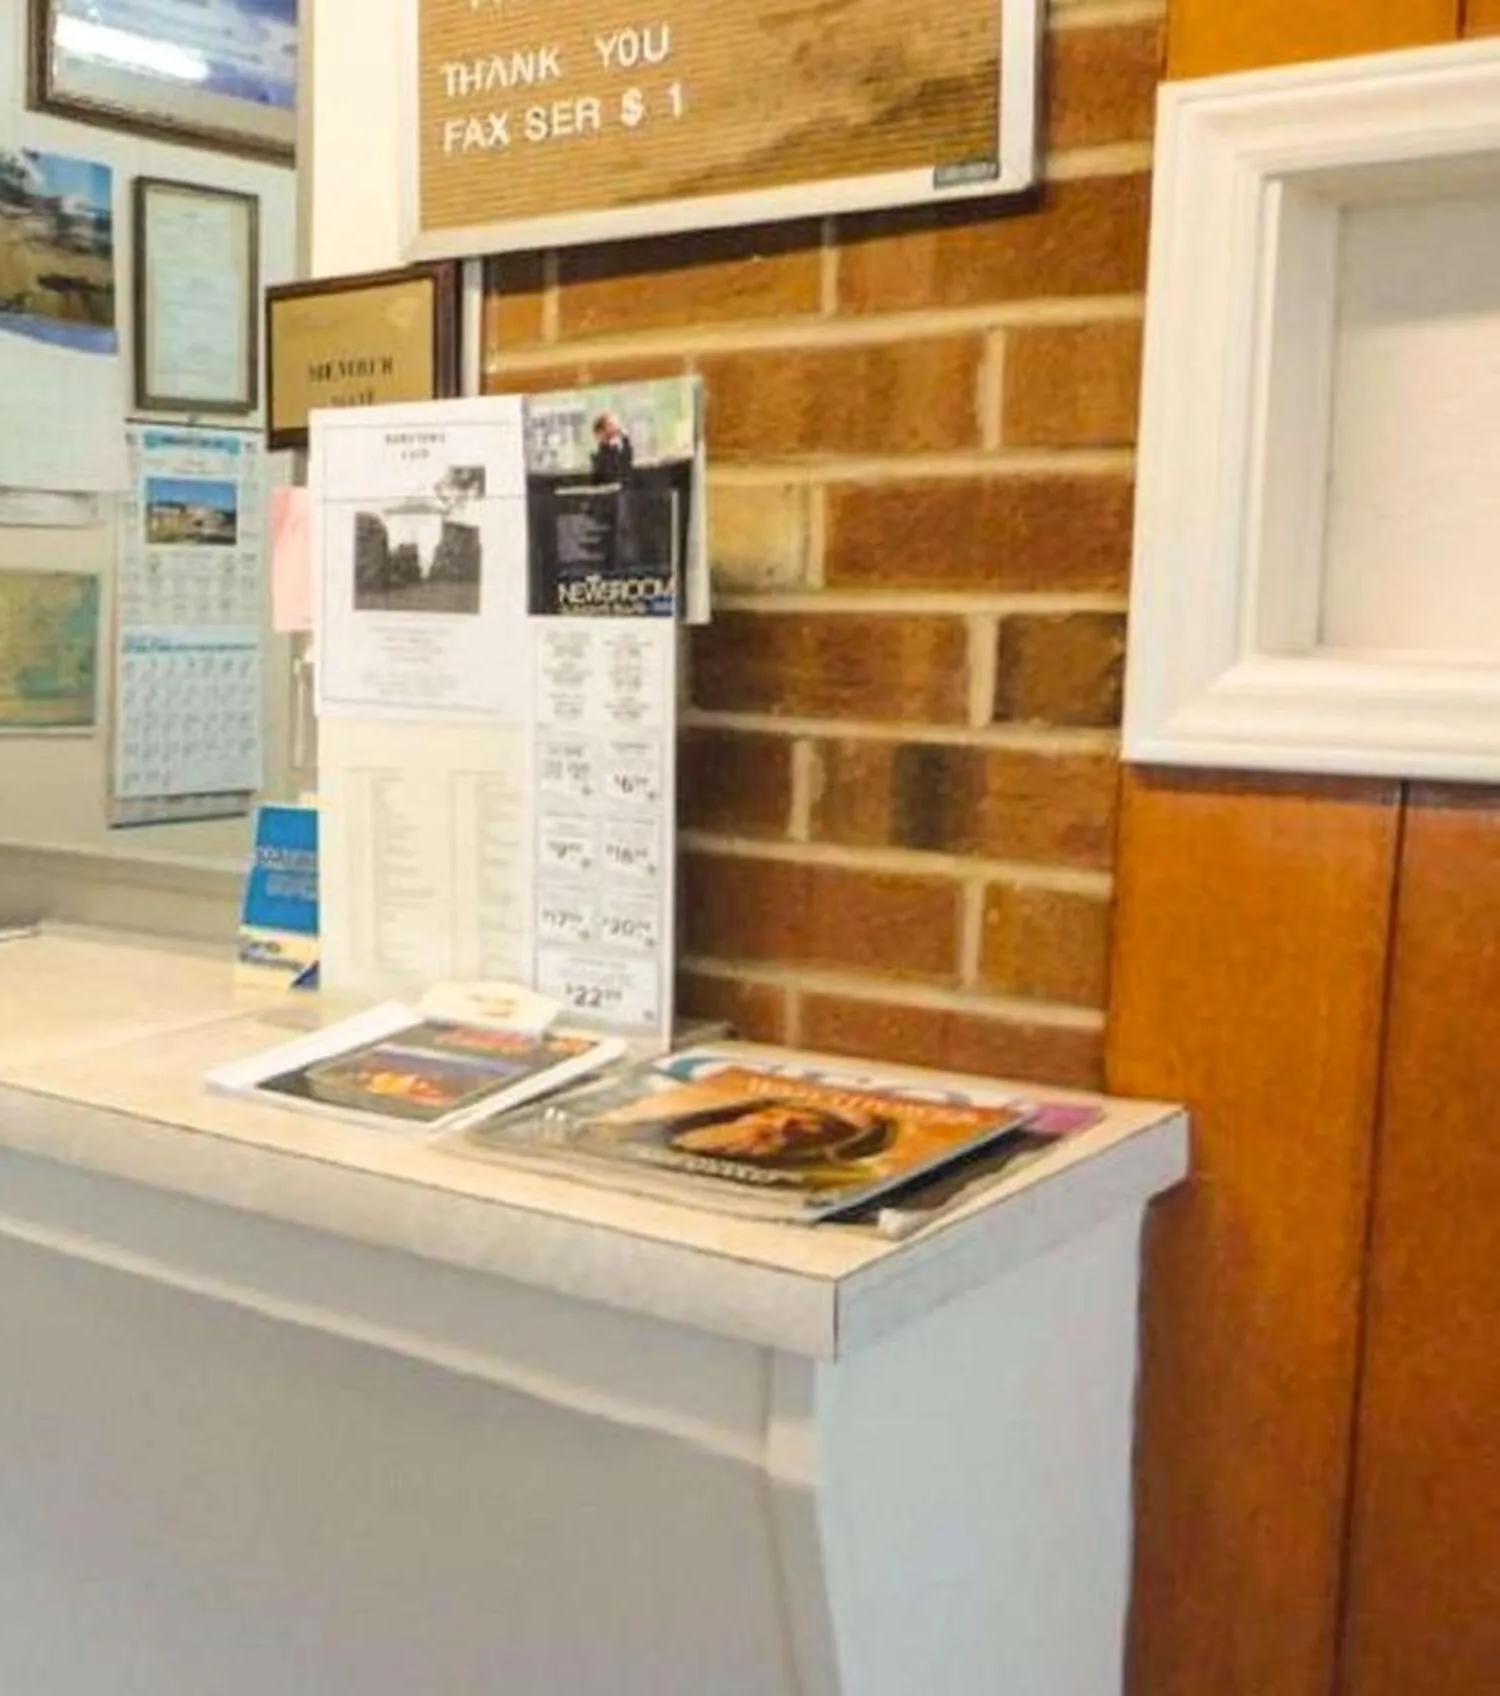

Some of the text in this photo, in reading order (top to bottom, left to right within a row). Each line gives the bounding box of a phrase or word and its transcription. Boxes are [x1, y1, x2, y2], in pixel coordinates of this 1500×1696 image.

[442, 21, 669, 97] THANK YOU
[444, 81, 682, 155] FAX SER $ 1
